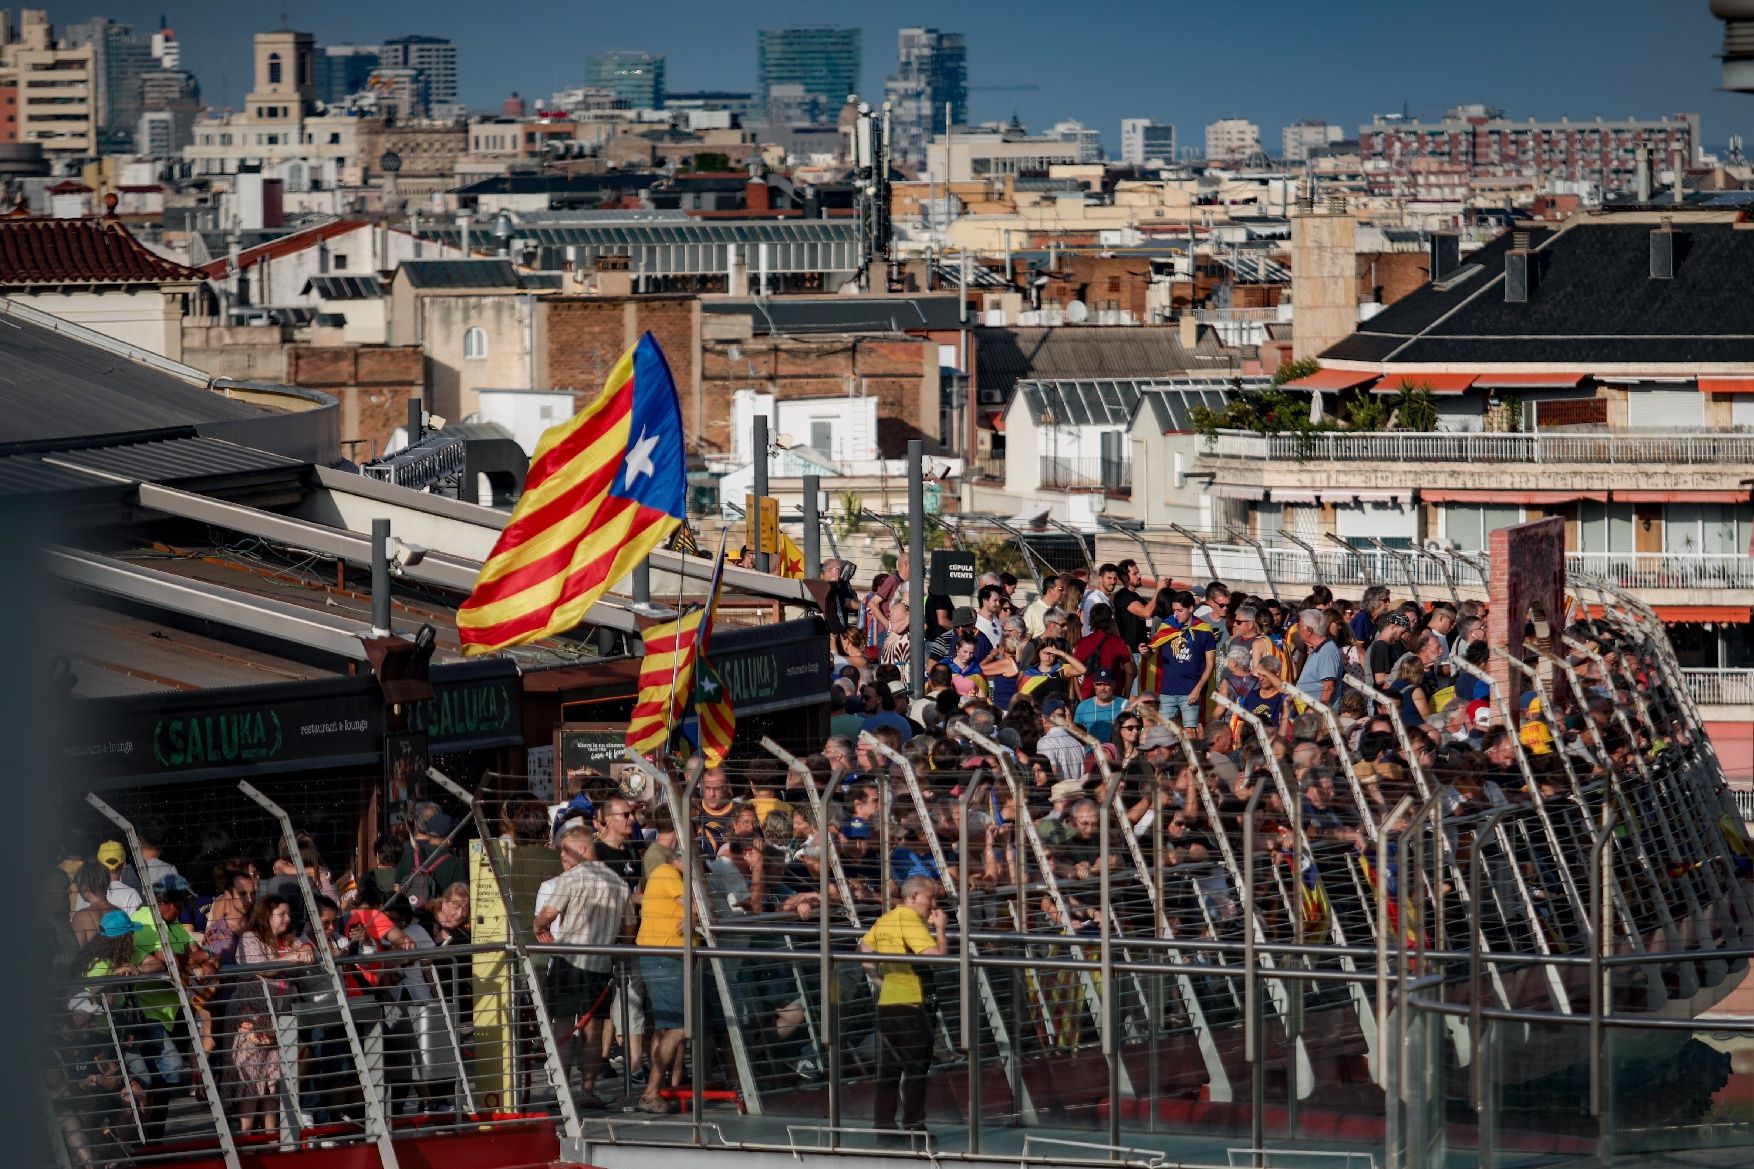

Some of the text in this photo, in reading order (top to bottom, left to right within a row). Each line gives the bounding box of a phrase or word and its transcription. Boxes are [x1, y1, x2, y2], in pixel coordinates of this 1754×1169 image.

[725, 655, 771, 701] SALUKA
[300, 720, 337, 735] restaurant
[344, 719, 368, 731] lounge
[428, 687, 498, 735] SALUKA
[109, 741, 133, 754] lounge
[169, 711, 266, 765] SALUKA
